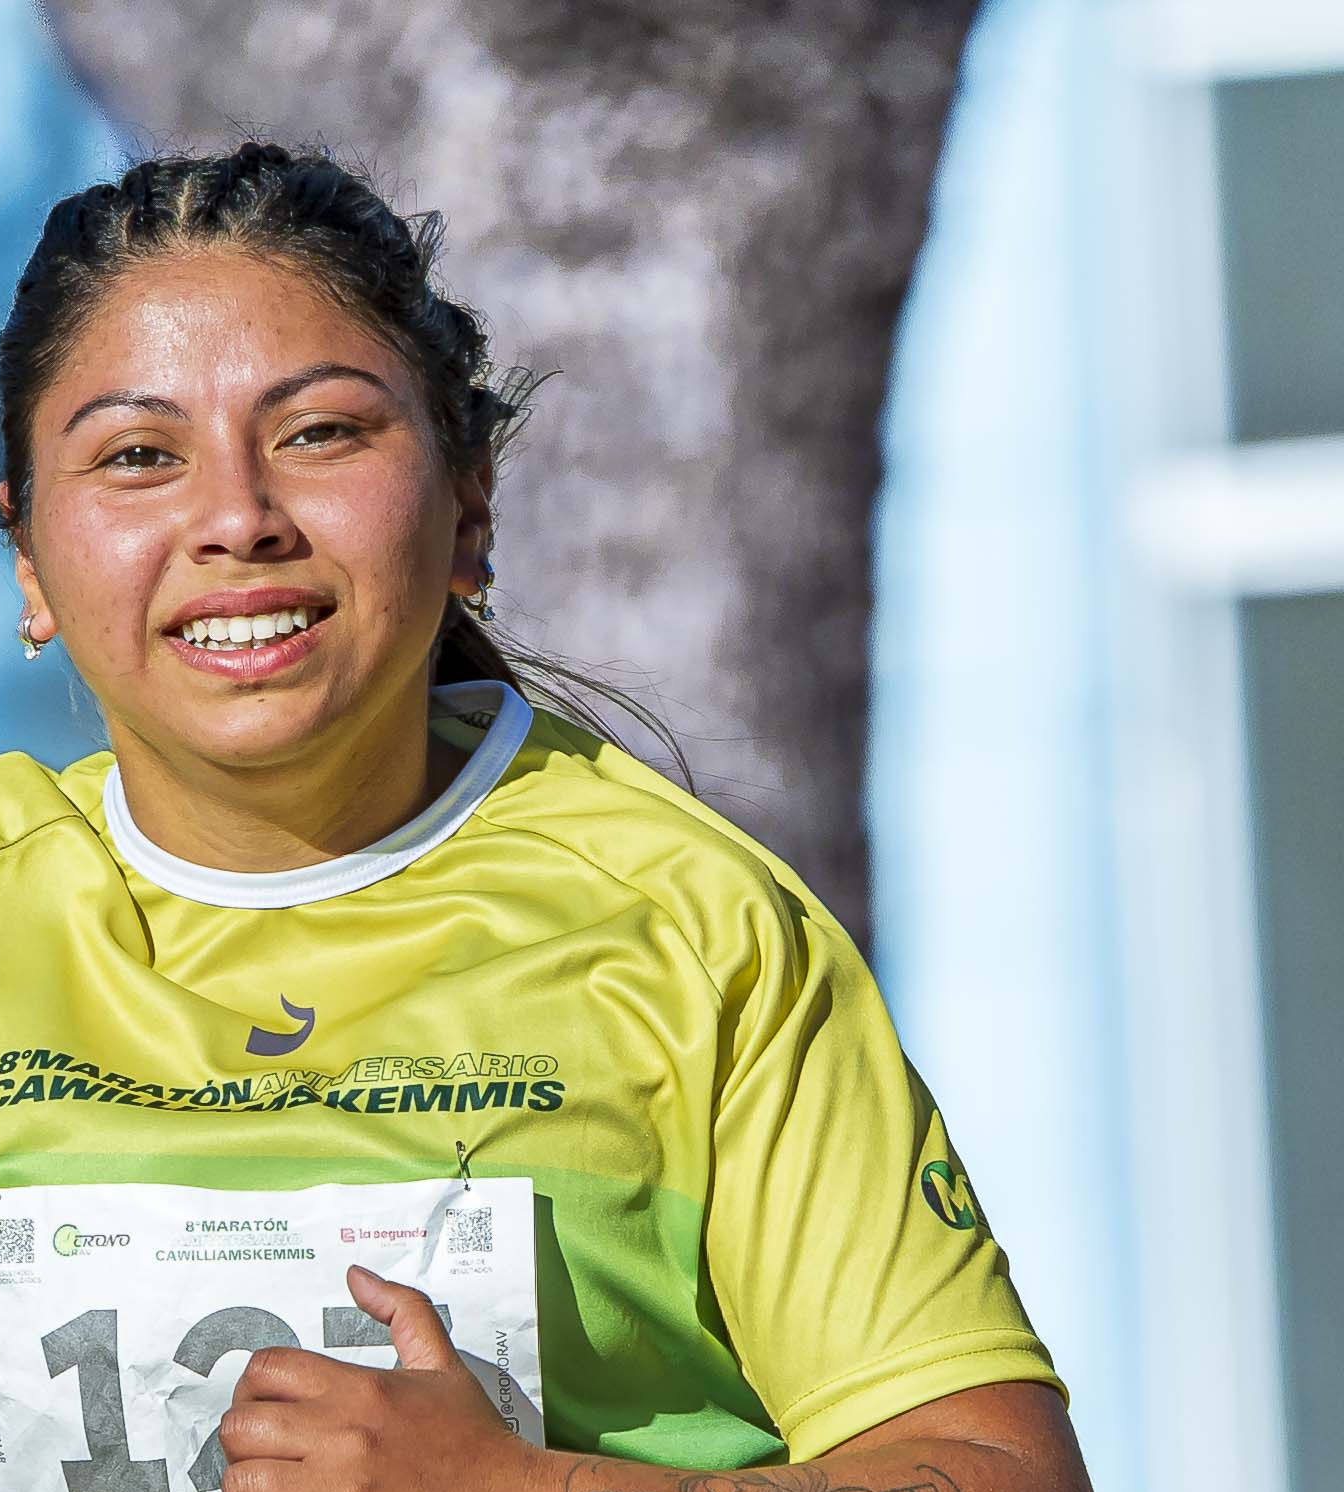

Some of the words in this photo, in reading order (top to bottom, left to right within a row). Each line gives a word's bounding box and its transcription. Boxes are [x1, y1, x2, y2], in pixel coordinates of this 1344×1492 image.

[373, 1227, 428, 1241] segunda
[155, 1248, 316, 1262] CAWILLIAMSKEMMIS
[496, 1330, 514, 1415] @CRONORAV
